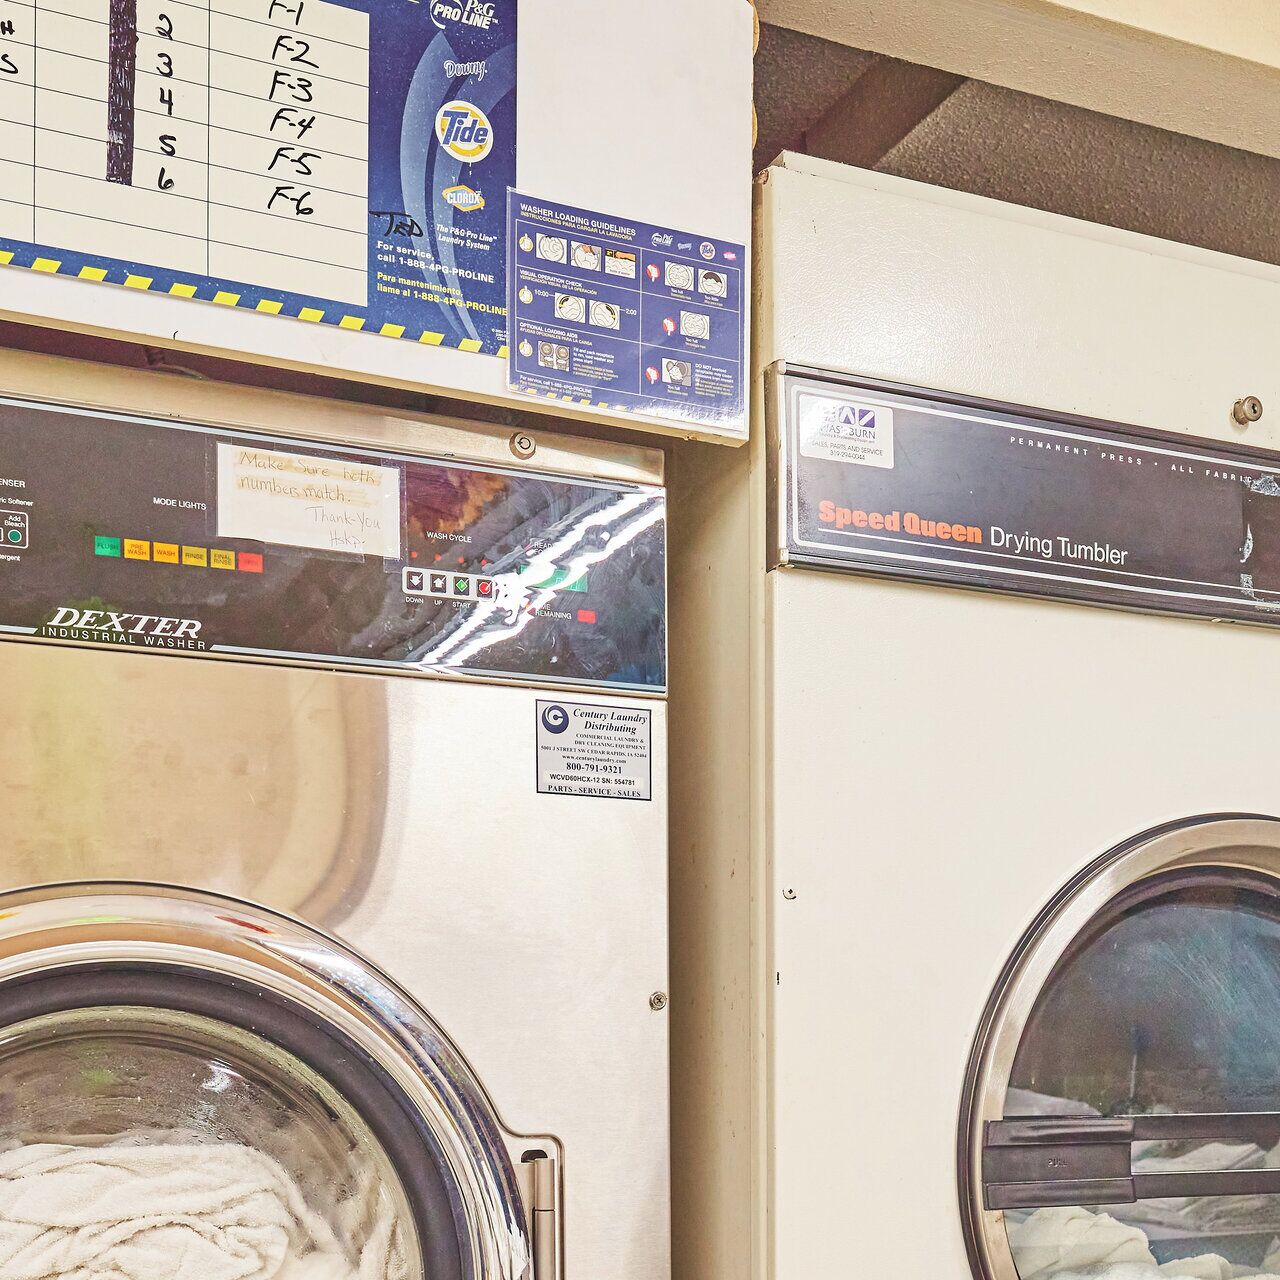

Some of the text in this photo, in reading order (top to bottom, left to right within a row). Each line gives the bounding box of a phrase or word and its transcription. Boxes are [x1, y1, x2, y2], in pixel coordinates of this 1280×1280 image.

[465, 0, 495, 17] P&G
[155, 14, 173, 41] 2
[272, 35, 319, 68] F-2
[157, 53, 173, 77] 3
[444, 60, 488, 81] Downy
[269, 71, 313, 102] F-3
[160, 87, 173, 115] 4
[270, 108, 315, 139] F-4
[442, 110, 489, 146] Tide
[268, 148, 321, 175] F-5
[158, 167, 174, 189] 6
[268, 187, 313, 215] F-6
[446, 192, 481, 205] CLOROX
[369, 211, 423, 237] TED
[520, 203, 636, 236] WASHER LOADING GUIDELINES
[378, 241, 435, 260] For service,
[438, 234, 490, 250] Laundry System
[378, 254, 495, 284] call 1-888-4PG-PROLINE
[520, 270, 537, 278] VISUAL
[537, 274, 565, 284] OPERATION
[377, 272, 464, 297] Para mantenimiento,
[535, 289, 549, 297] 10:00
[861, 447, 883, 456] SERVICE
[1010, 436, 1088, 456] PERMANENT
[1101, 453, 1142, 466] PRESS
[1171, 464, 1194, 474] ALL
[239, 451, 284, 470] Make
[344, 467, 375, 483] both
[240, 477, 352, 502] numbers match.
[8, 498, 34, 507] Softener
[153, 497, 207, 510] MODE LIGHTS
[4, 520, 25, 528] Bleach
[818, 500, 1129, 566] Speed Queen Drying Tumbler
[96, 542, 120, 550] FLUSH
[427, 531, 472, 543] WASH CYCLE
[47, 607, 202, 638] DEXTER
[536, 610, 572, 620] REMAINING
[42, 626, 206, 650] INDUSTRIAL WASHER
[573, 708, 648, 724] Century Laundry
[584, 721, 637, 735] Distributing
[562, 755, 626, 764] www.centurylaundry.com
[566, 762, 622, 774] 800-791-9321
[548, 785, 573, 793] PARTS
[579, 787, 612, 796] SERVICE
